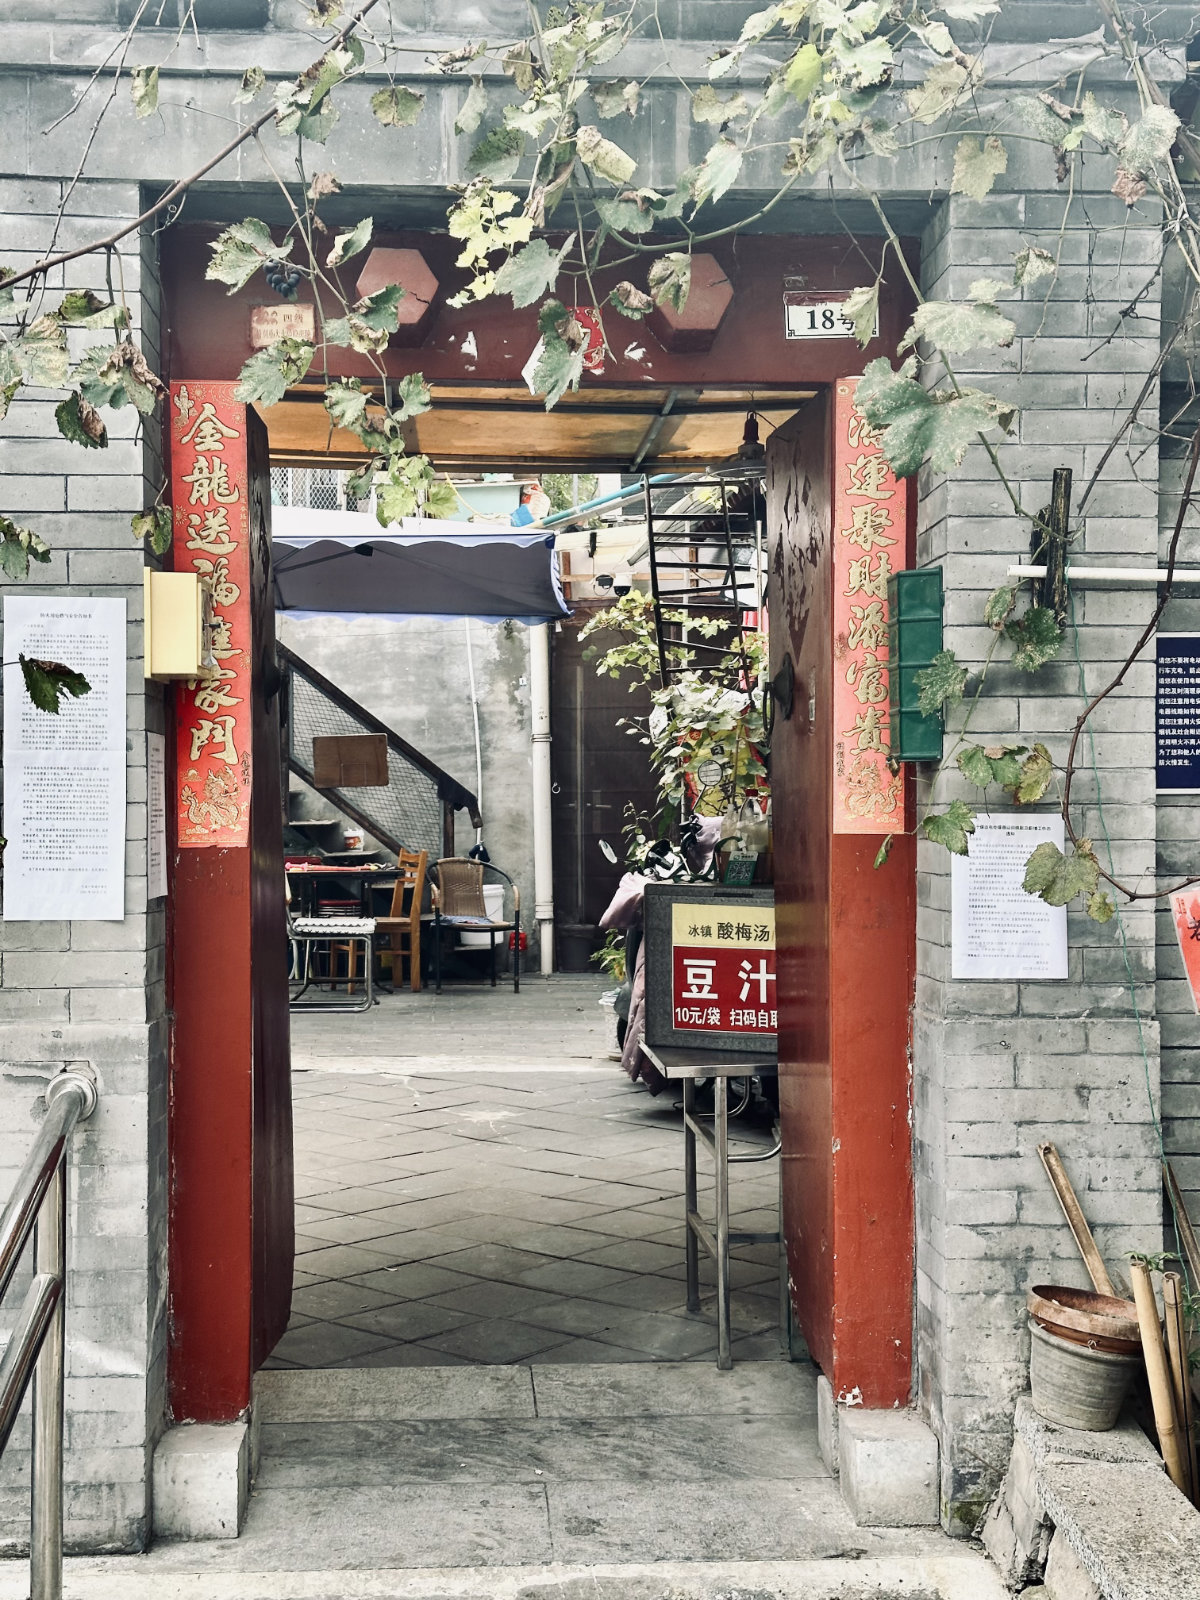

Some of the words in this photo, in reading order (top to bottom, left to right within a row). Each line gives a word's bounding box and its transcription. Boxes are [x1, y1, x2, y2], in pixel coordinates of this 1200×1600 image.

[688, 924, 713, 938] 冰镇
[717, 922, 770, 942] 酸梅汤
[681, 958, 777, 1004] 豆汁
[675, 1006, 721, 1026] 10元/袋
